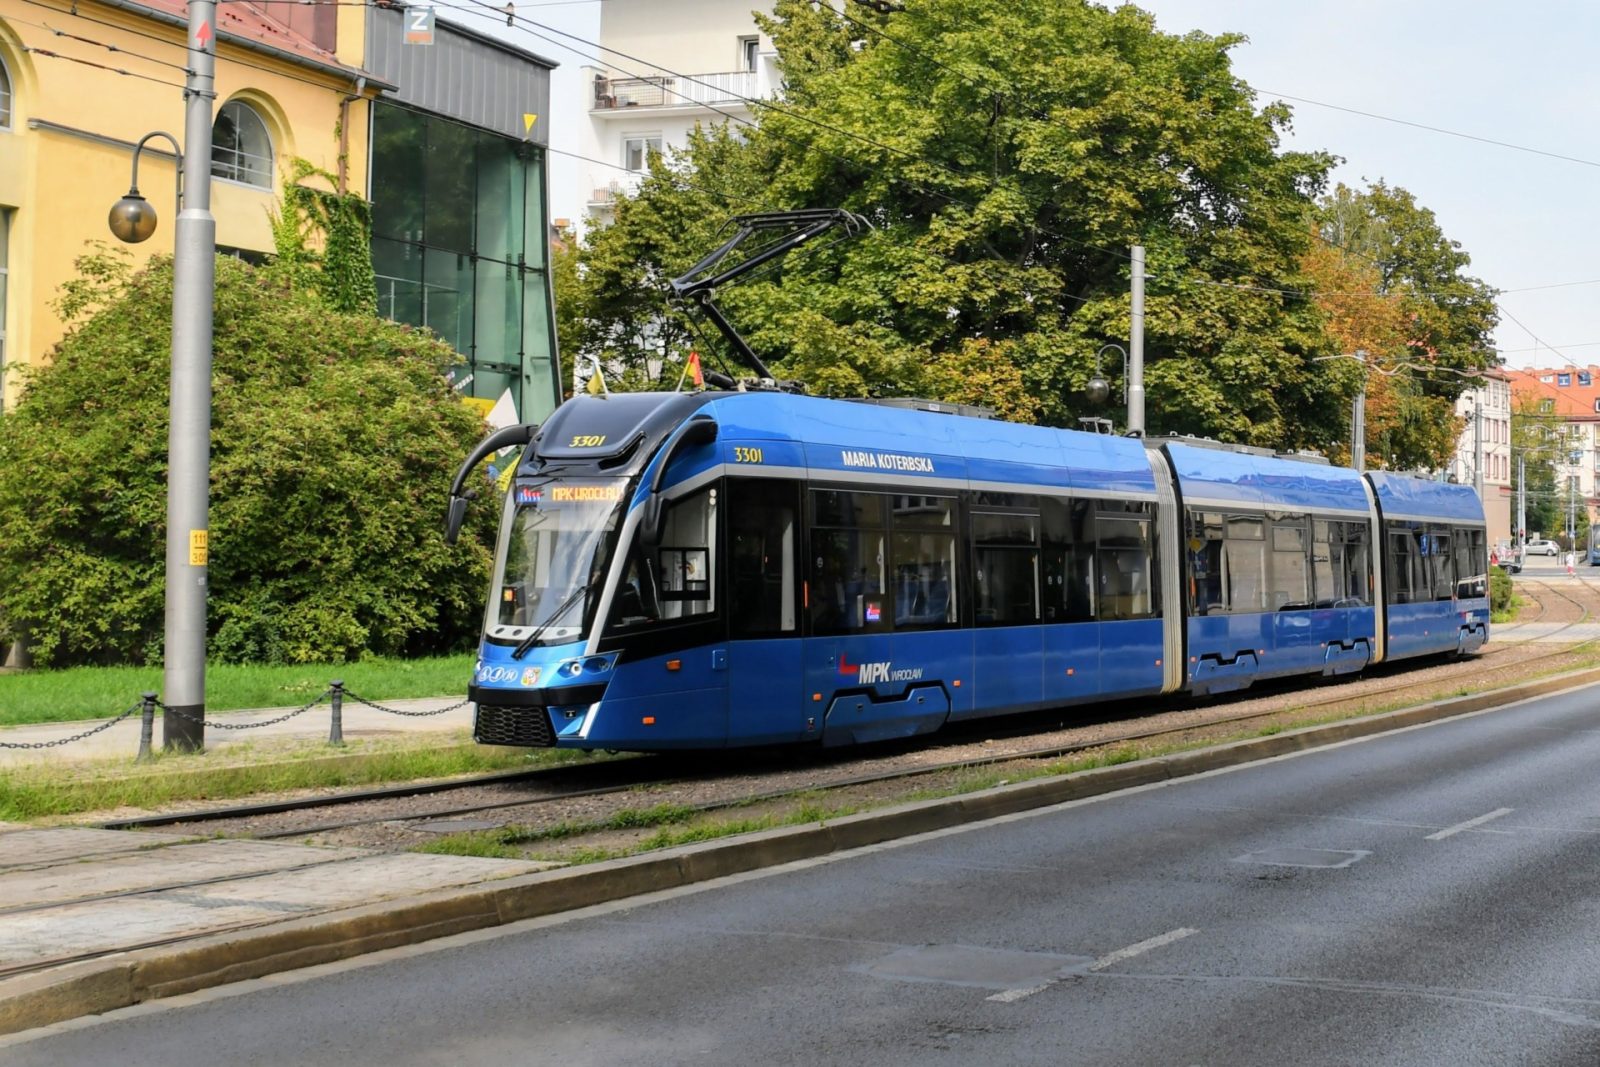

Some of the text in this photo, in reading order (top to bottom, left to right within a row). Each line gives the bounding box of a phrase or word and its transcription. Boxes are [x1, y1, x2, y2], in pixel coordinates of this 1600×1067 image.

[411, 11, 428, 30] Z
[569, 435, 606, 448] 3301
[734, 447, 762, 463] 3301
[842, 450, 935, 472] MARIA KOTERBSKA
[552, 487, 573, 501] MPK
[858, 661, 891, 684] MPK
